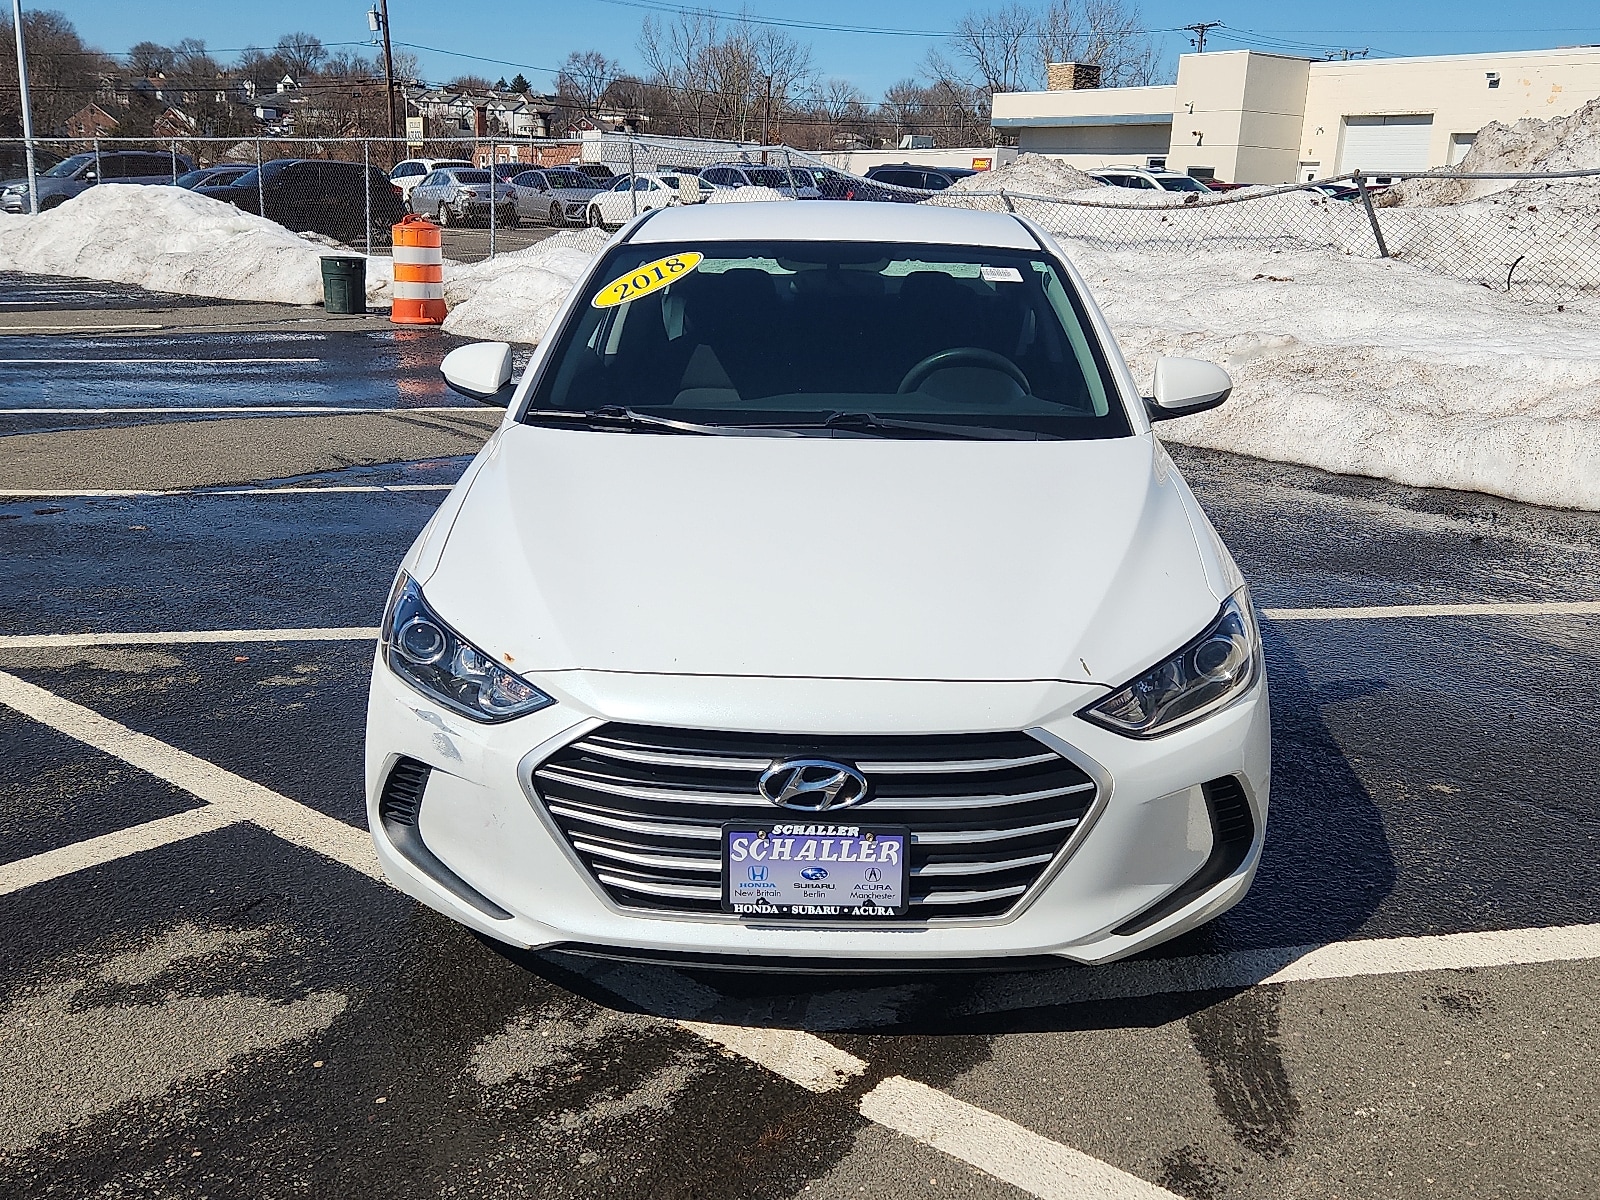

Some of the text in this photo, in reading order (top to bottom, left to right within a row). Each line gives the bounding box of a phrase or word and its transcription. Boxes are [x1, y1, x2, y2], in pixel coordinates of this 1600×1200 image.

[613, 258, 686, 301] 2018
[771, 824, 860, 837] SCHALLER
[730, 838, 900, 866] SCHALLER
[793, 882, 836, 890] SUBARU
[734, 889, 781, 897] New Britain
[803, 890, 826, 898] Berlin
[849, 891, 896, 900] Manchester
[733, 904, 895, 916] HONDA SUBARU ACURA
